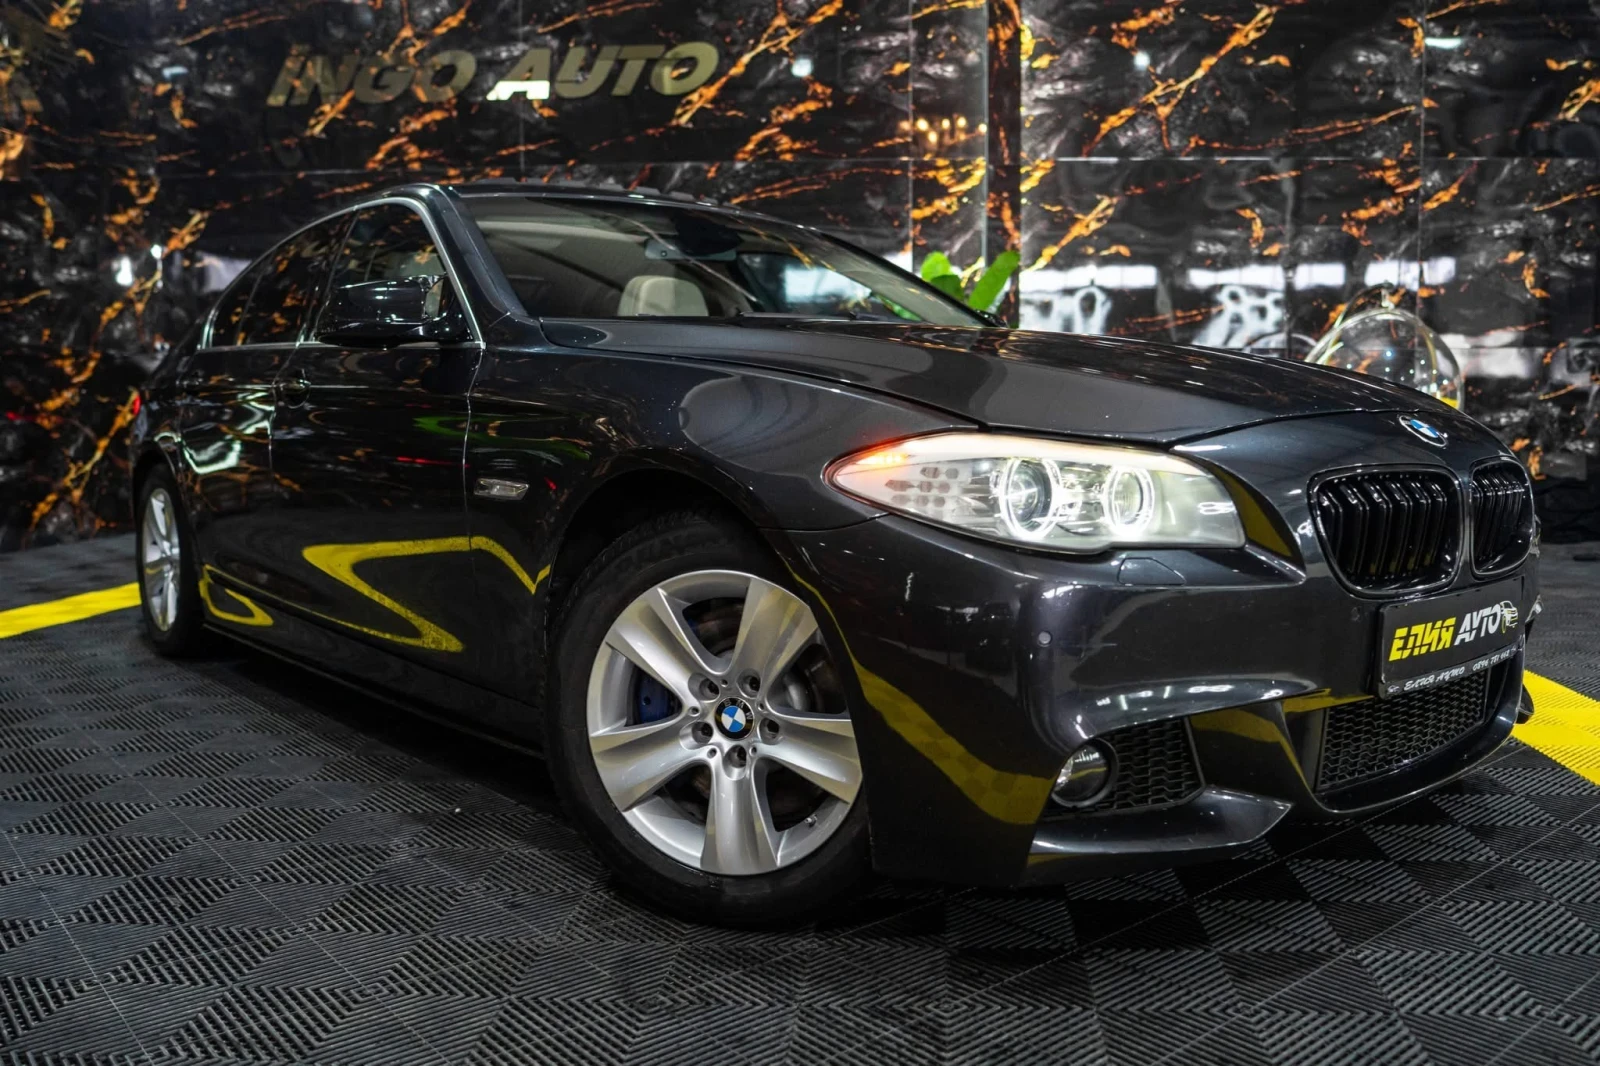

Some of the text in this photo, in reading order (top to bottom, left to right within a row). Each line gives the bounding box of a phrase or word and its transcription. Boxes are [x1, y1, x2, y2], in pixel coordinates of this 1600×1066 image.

[267, 41, 718, 106] INGO AUTO
[723, 698, 754, 720] BMW
